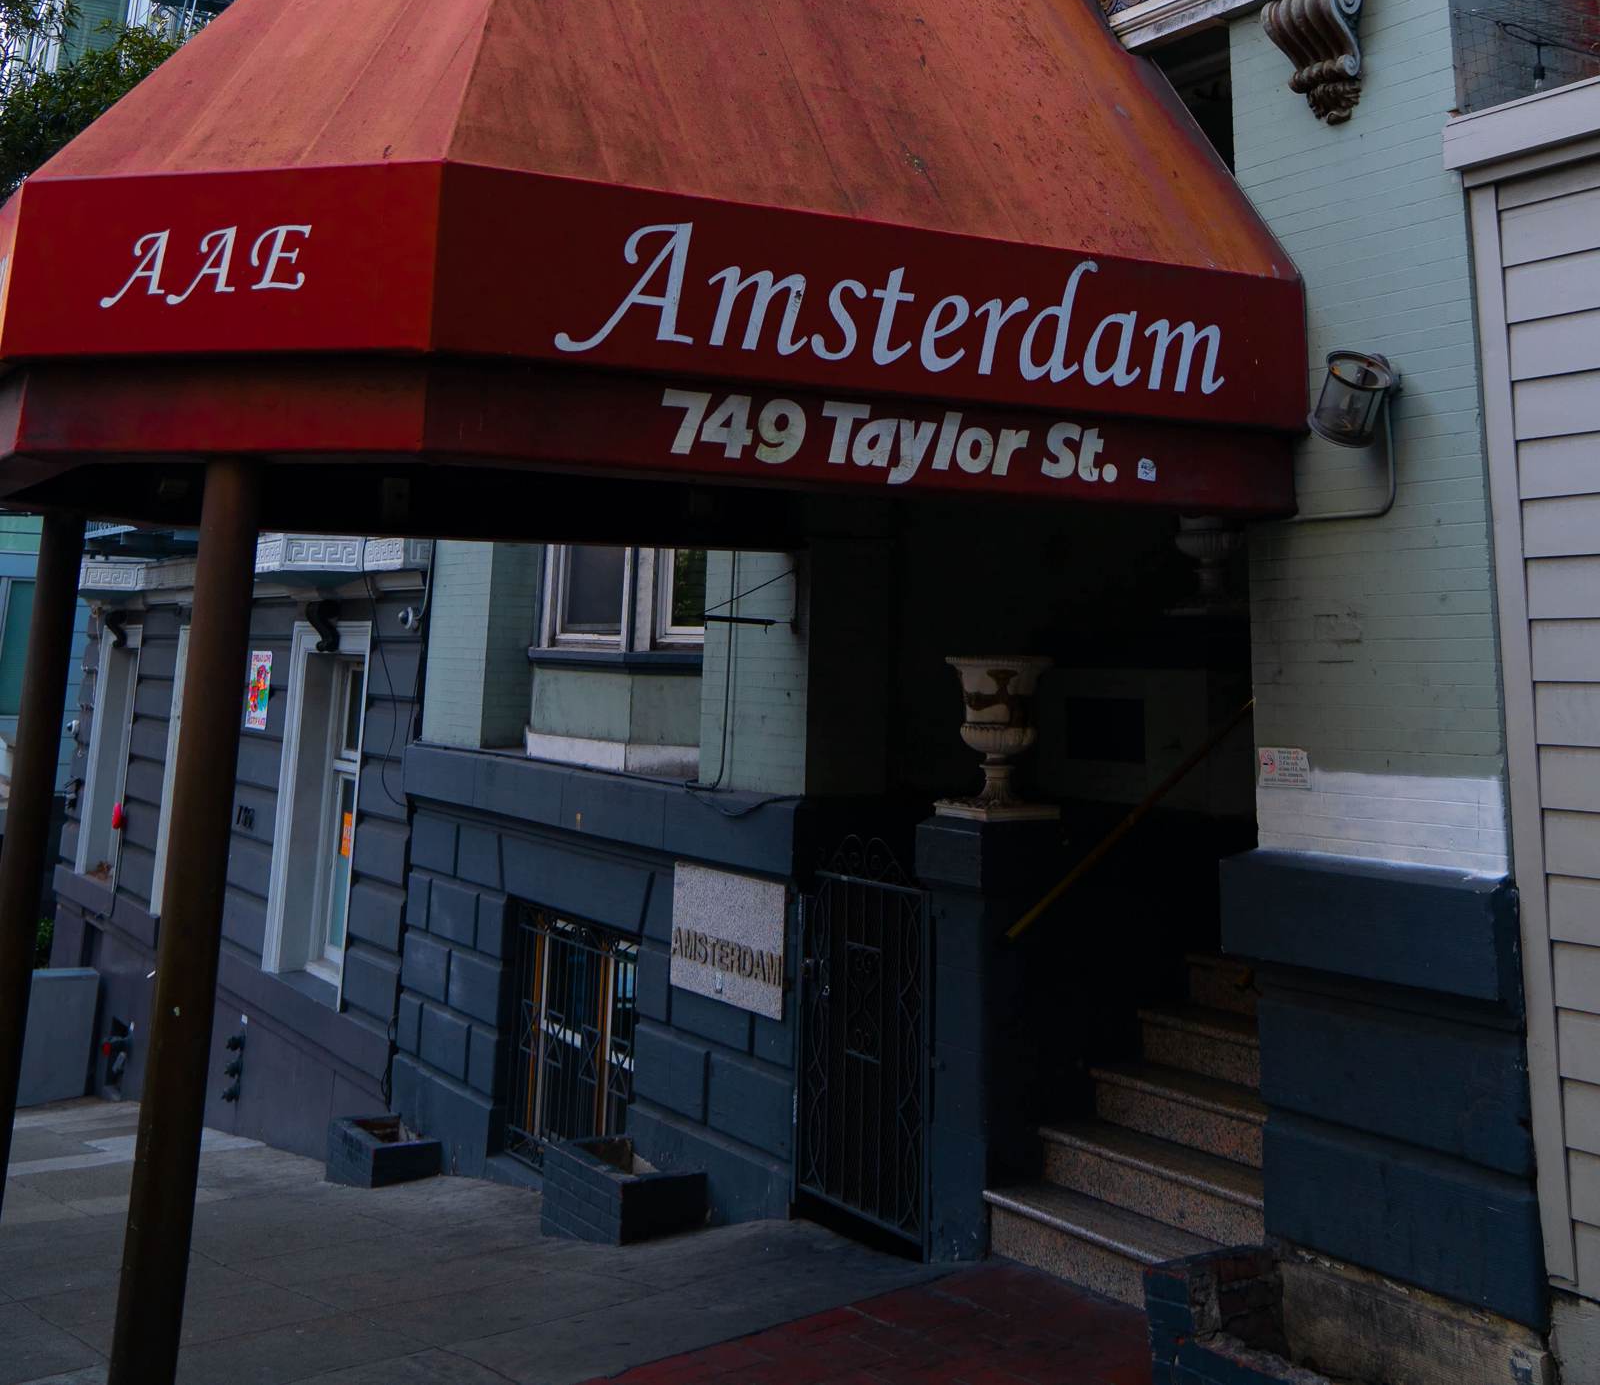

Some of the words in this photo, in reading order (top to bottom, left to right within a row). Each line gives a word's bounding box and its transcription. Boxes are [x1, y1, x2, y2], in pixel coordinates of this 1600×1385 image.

[100, 224, 313, 309] AAE
[554, 222, 1226, 395] Amsterdam
[661, 388, 807, 465] 749
[821, 400, 1031, 485] Taylor
[1040, 421, 1118, 483] St.
[672, 926, 783, 987] AMSTERDAM
